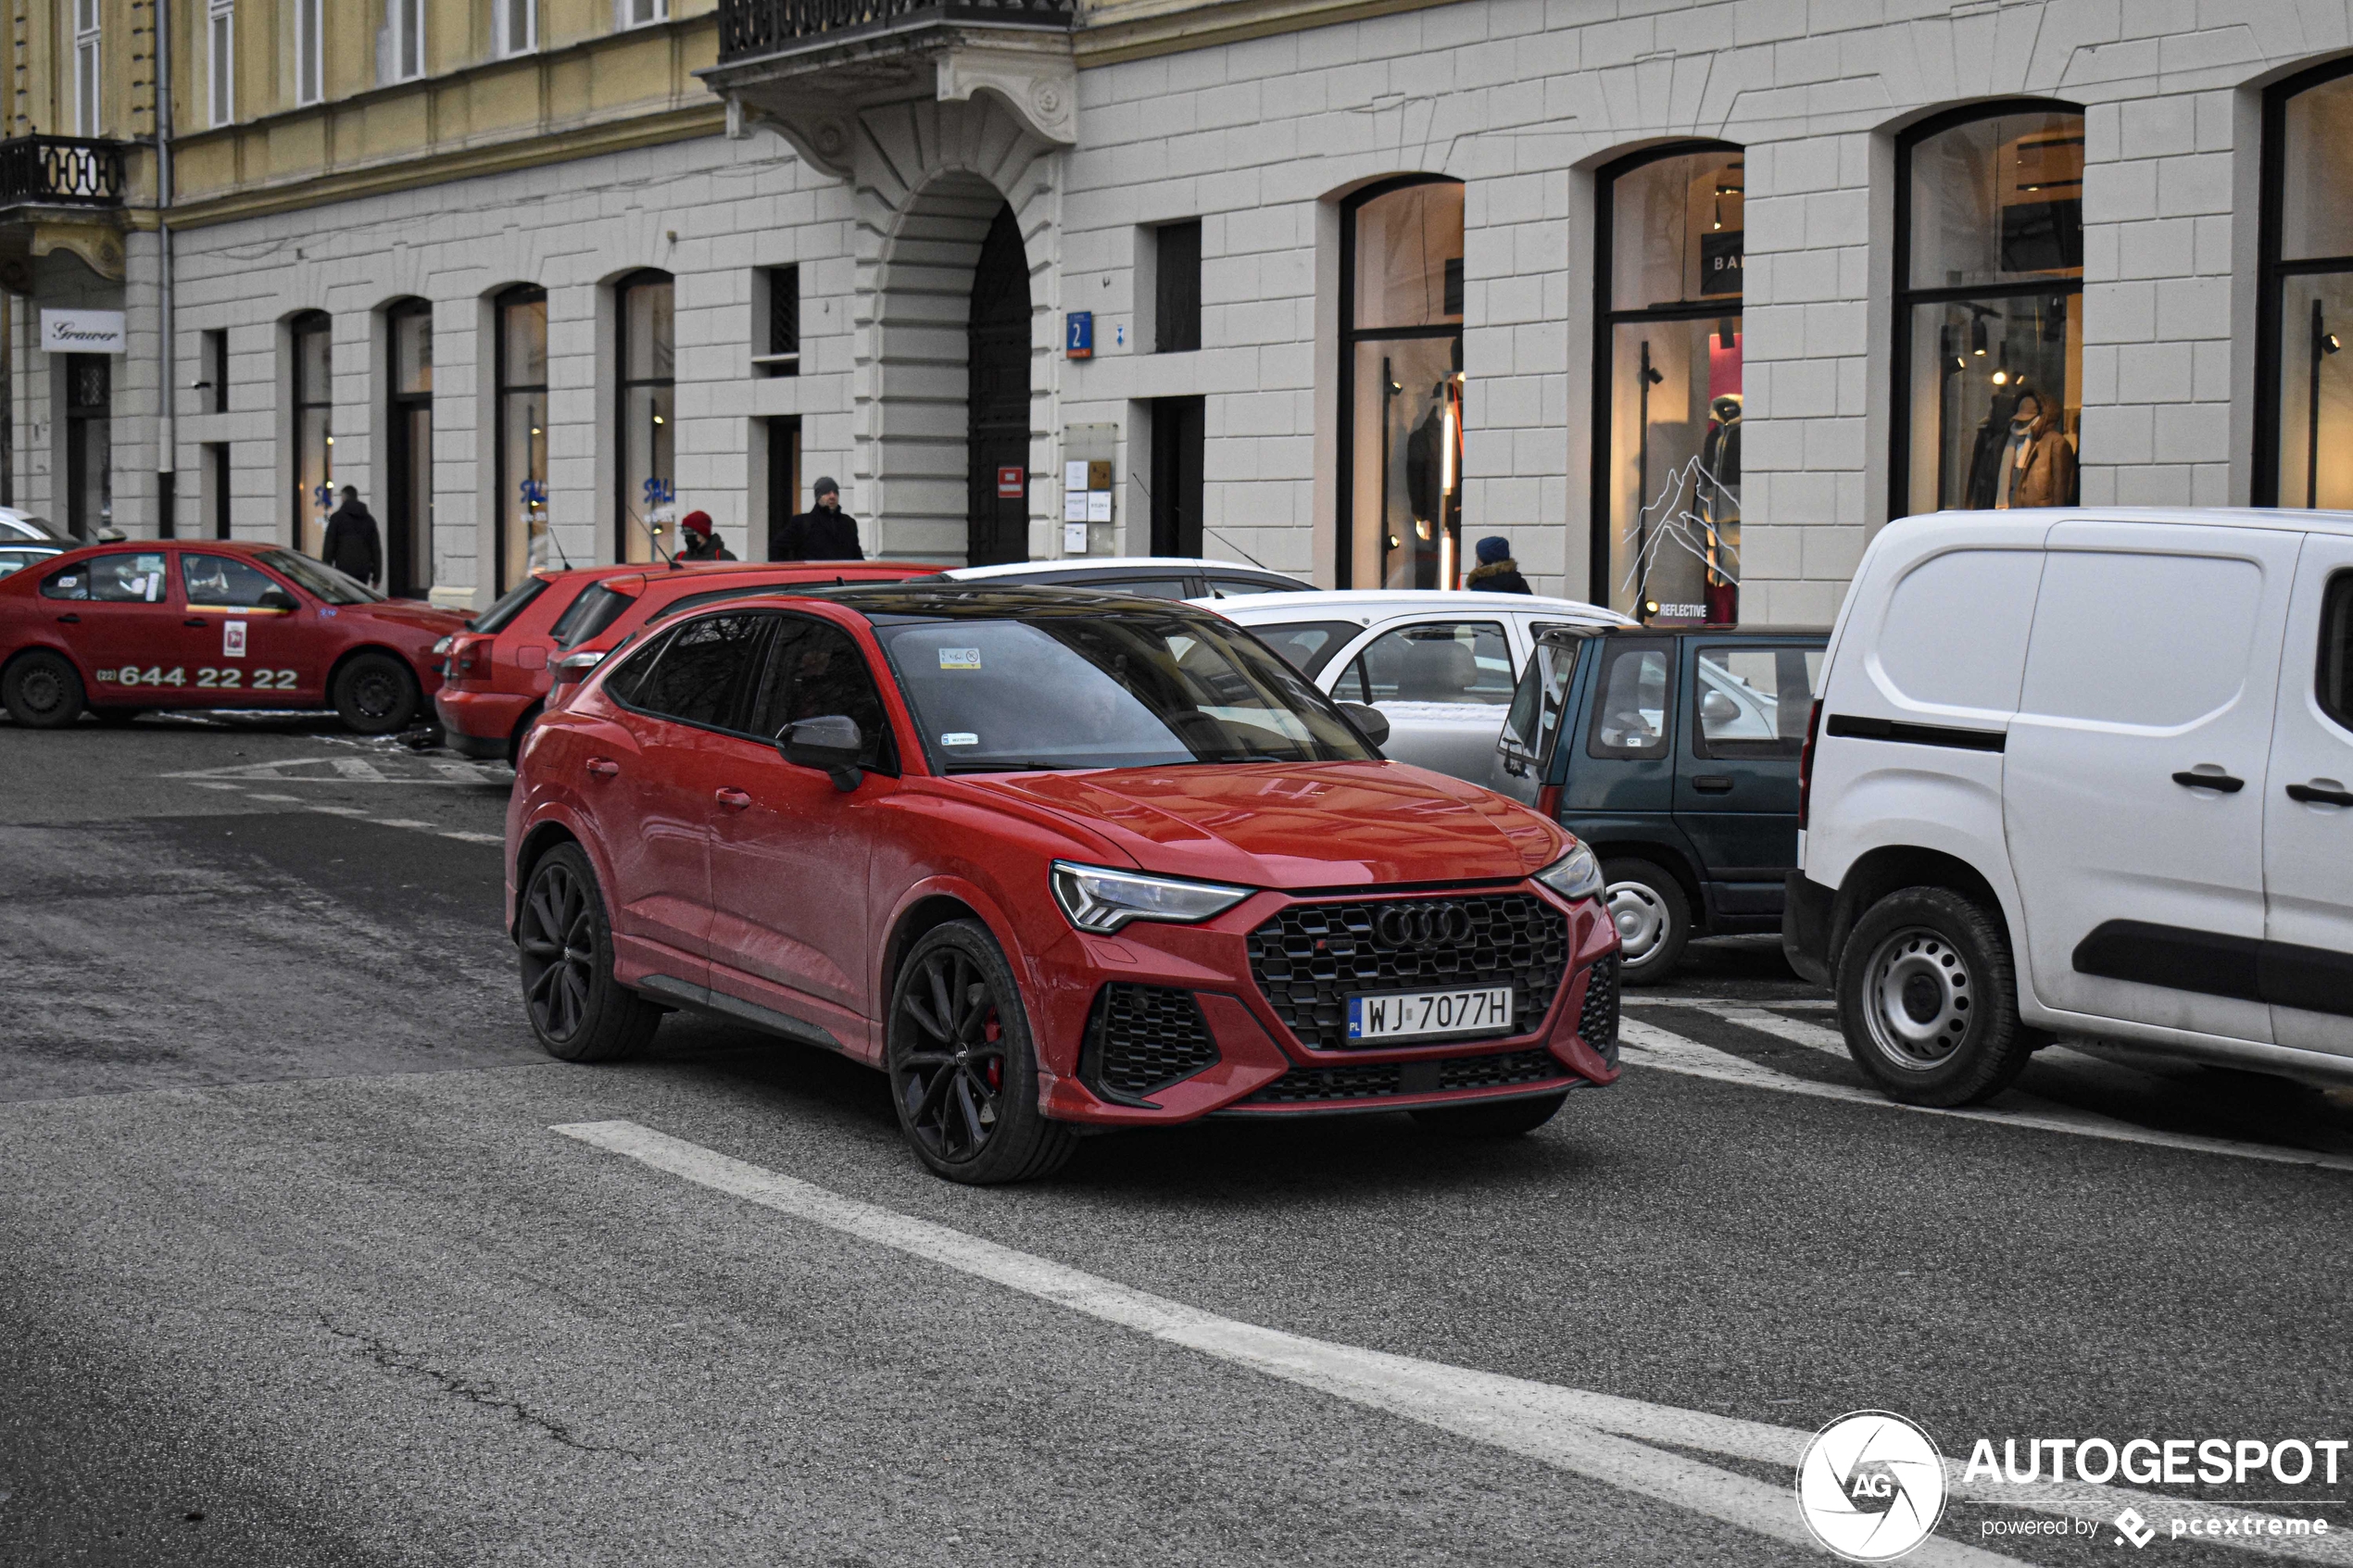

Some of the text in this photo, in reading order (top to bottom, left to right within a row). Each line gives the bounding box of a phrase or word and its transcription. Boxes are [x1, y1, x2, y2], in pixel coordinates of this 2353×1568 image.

[52, 320, 119, 342] Grawer
[1073, 323, 1081, 347] 2
[1659, 603, 1707, 618] REFLECTIVE
[119, 666, 186, 687] 644
[196, 668, 243, 688] 22
[252, 669, 298, 690] 22
[1369, 990, 1506, 1033] WJ 7077H
[1349, 1022, 1361, 1033] PL
